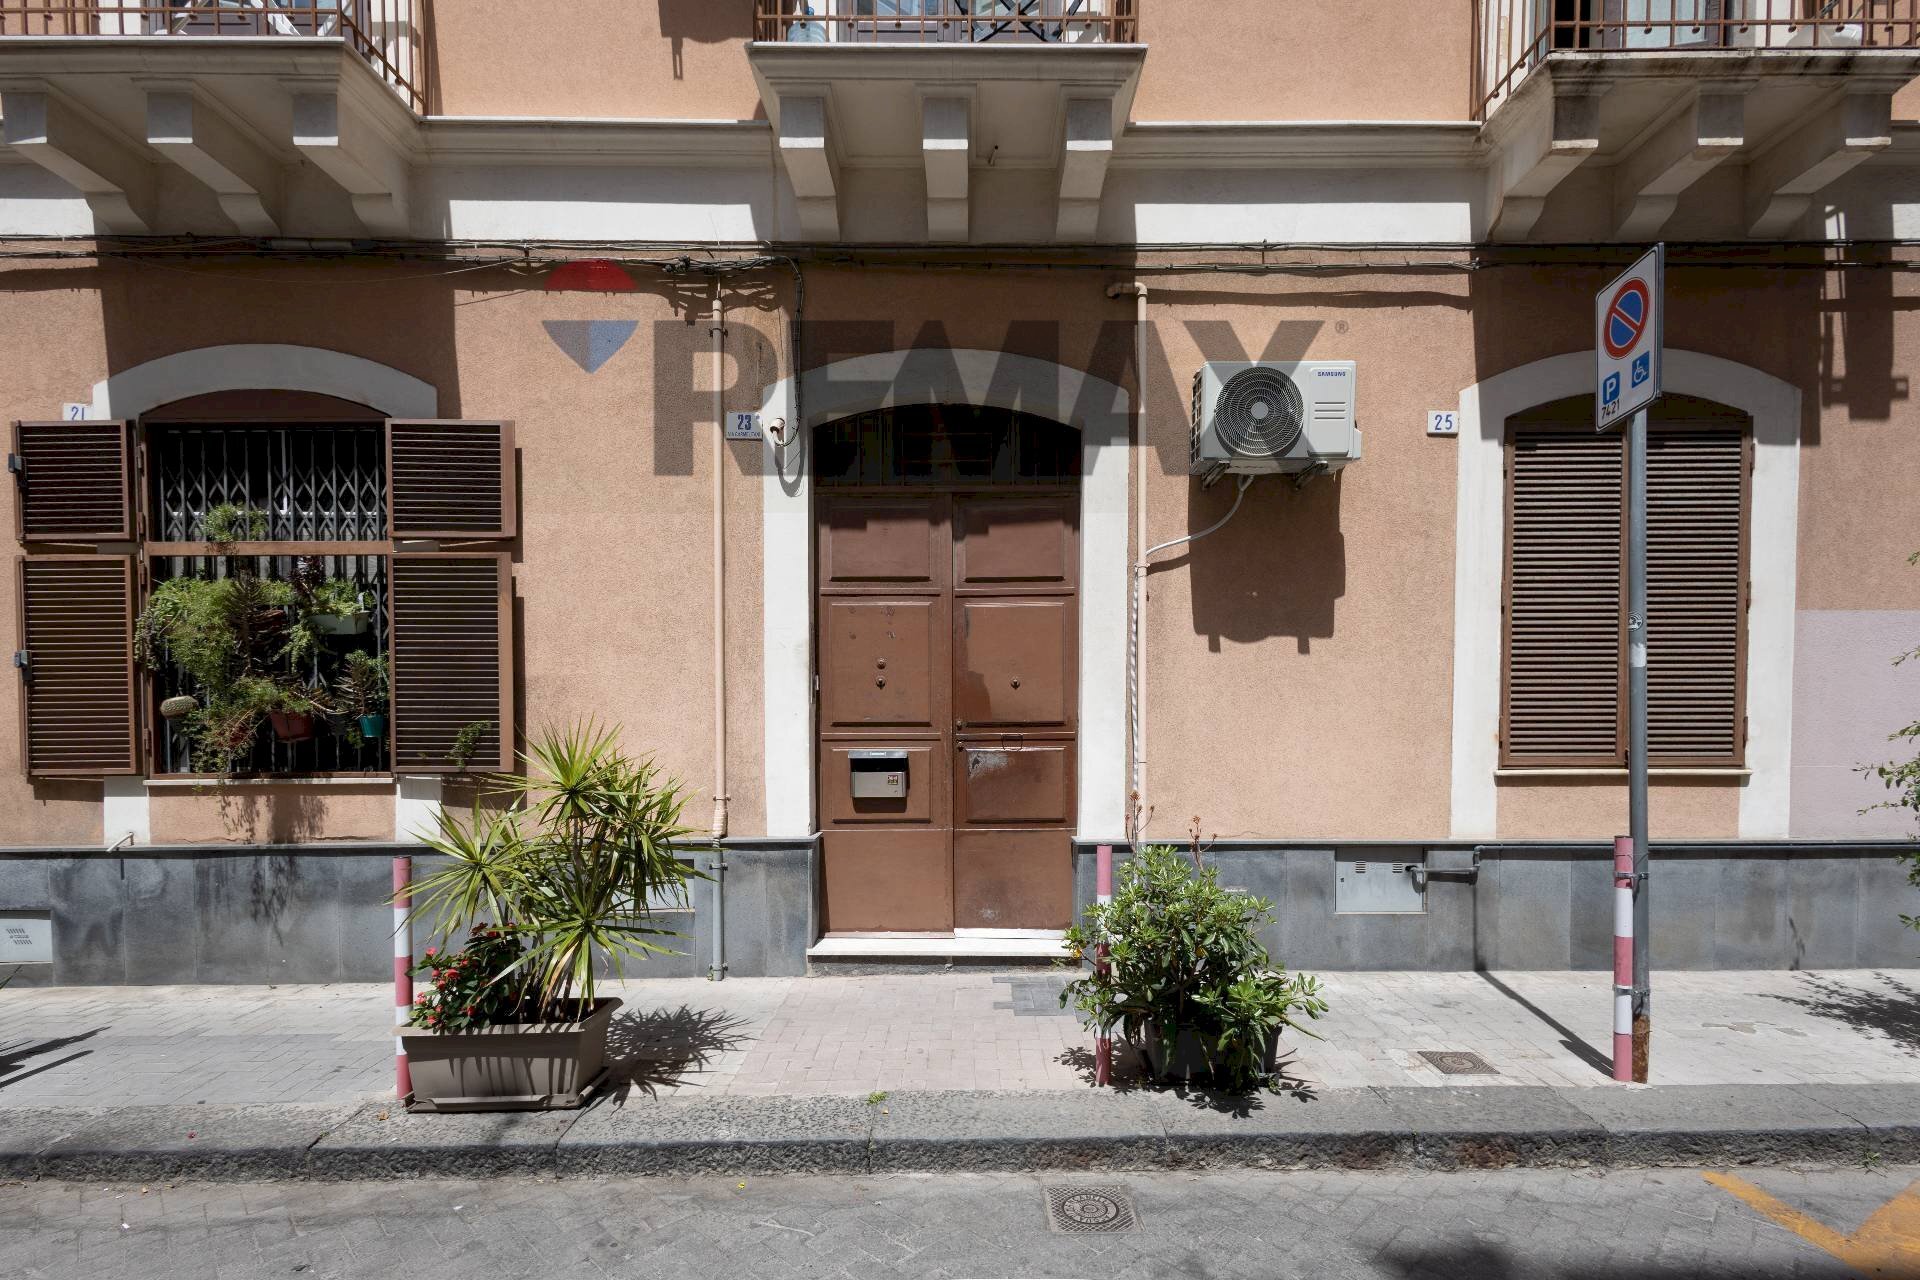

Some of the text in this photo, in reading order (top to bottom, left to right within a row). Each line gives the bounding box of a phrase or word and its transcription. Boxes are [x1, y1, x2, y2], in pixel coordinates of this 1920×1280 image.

[1606, 377, 1617, 401] P
[71, 406, 85, 420] 21
[1601, 398, 1620, 419] 7421
[737, 413, 752, 430] 23
[1434, 414, 1453, 430] 25
